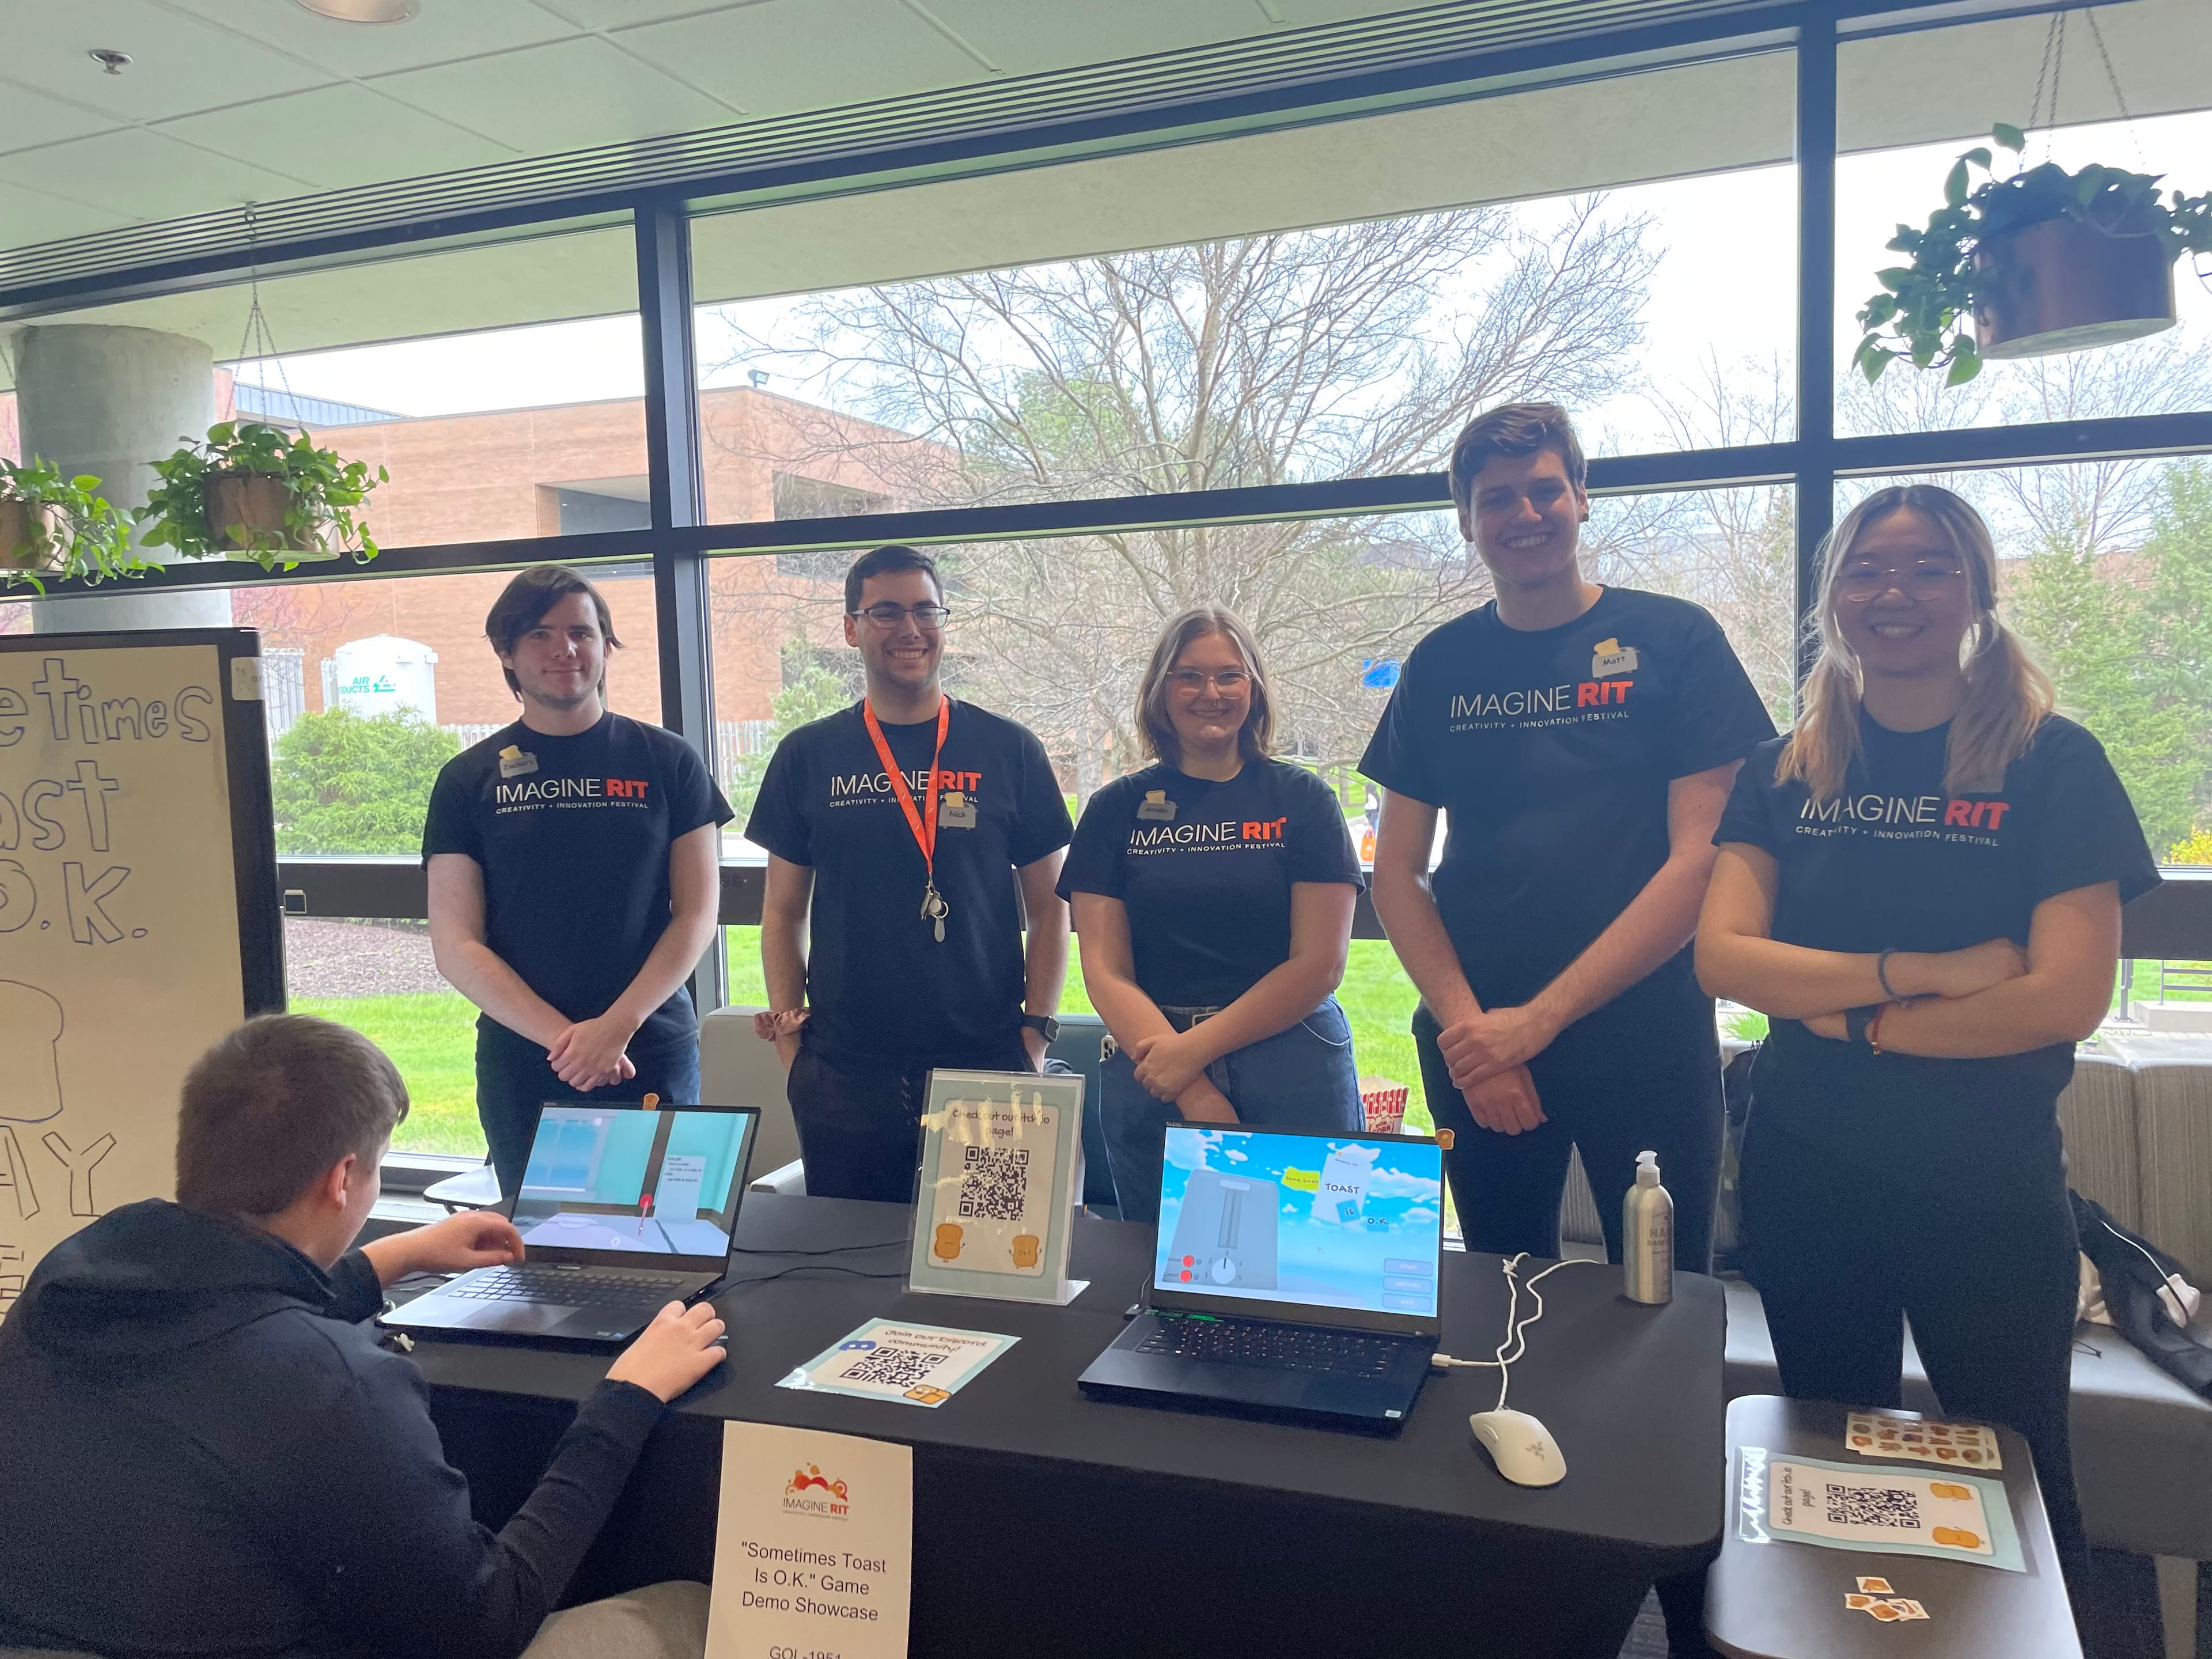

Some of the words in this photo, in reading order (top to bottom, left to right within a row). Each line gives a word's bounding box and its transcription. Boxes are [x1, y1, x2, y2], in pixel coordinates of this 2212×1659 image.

[1603, 656, 1625, 666] Matt
[353, 677, 370, 685] AIR
[1450, 684, 1571, 718] IMAGINE
[1577, 681, 1633, 707] RIT
[1450, 722, 1506, 732] CREATIVITY
[1520, 717, 1578, 728] INNOVATION
[1582, 711, 1630, 722] FESTIVAL
[496, 778, 602, 803] IMAGINE
[607, 778, 649, 799] RIT
[831, 770, 930, 797] IMAGNE
[938, 771, 982, 791] RIT
[496, 804, 546, 815] CREATIVITY
[556, 801, 608, 809] INNOVATION
[611, 801, 649, 809] FESTIVAL
[830, 798, 877, 808] CREATIVITY
[1800, 794, 1941, 824] IMAGINE
[1945, 799, 2010, 830] RIT
[1130, 821, 1237, 847] IMAGINE
[1243, 816, 1286, 841] RIT
[1874, 829, 1940, 840] INNOVATION
[1945, 834, 1999, 847] FESTIVAL
[1127, 847, 1177, 856] CREATIVITY
[1188, 843, 1241, 853] INNOVATION
[985, 1126, 1014, 1139] page!
[1325, 1183, 1360, 1194] TOAST
[885, 1330, 912, 1338] Join
[939, 1336, 988, 1347] Discord
[888, 1339, 961, 1354] community!
[783, 1497, 828, 1514] IMAGINE
[830, 1503, 850, 1515] RIT
[1781, 1495, 1793, 1506] out
[1782, 1507, 1793, 1525] Check
[741, 1541, 836, 1566] "Sometimes
[842, 1553, 887, 1573] Toast
[755, 1567, 768, 1584] Is
[774, 1570, 816, 1588] O.K."
[821, 1575, 870, 1595] Game
[742, 1590, 790, 1611] Demo
[795, 1596, 879, 1622] Showcase
